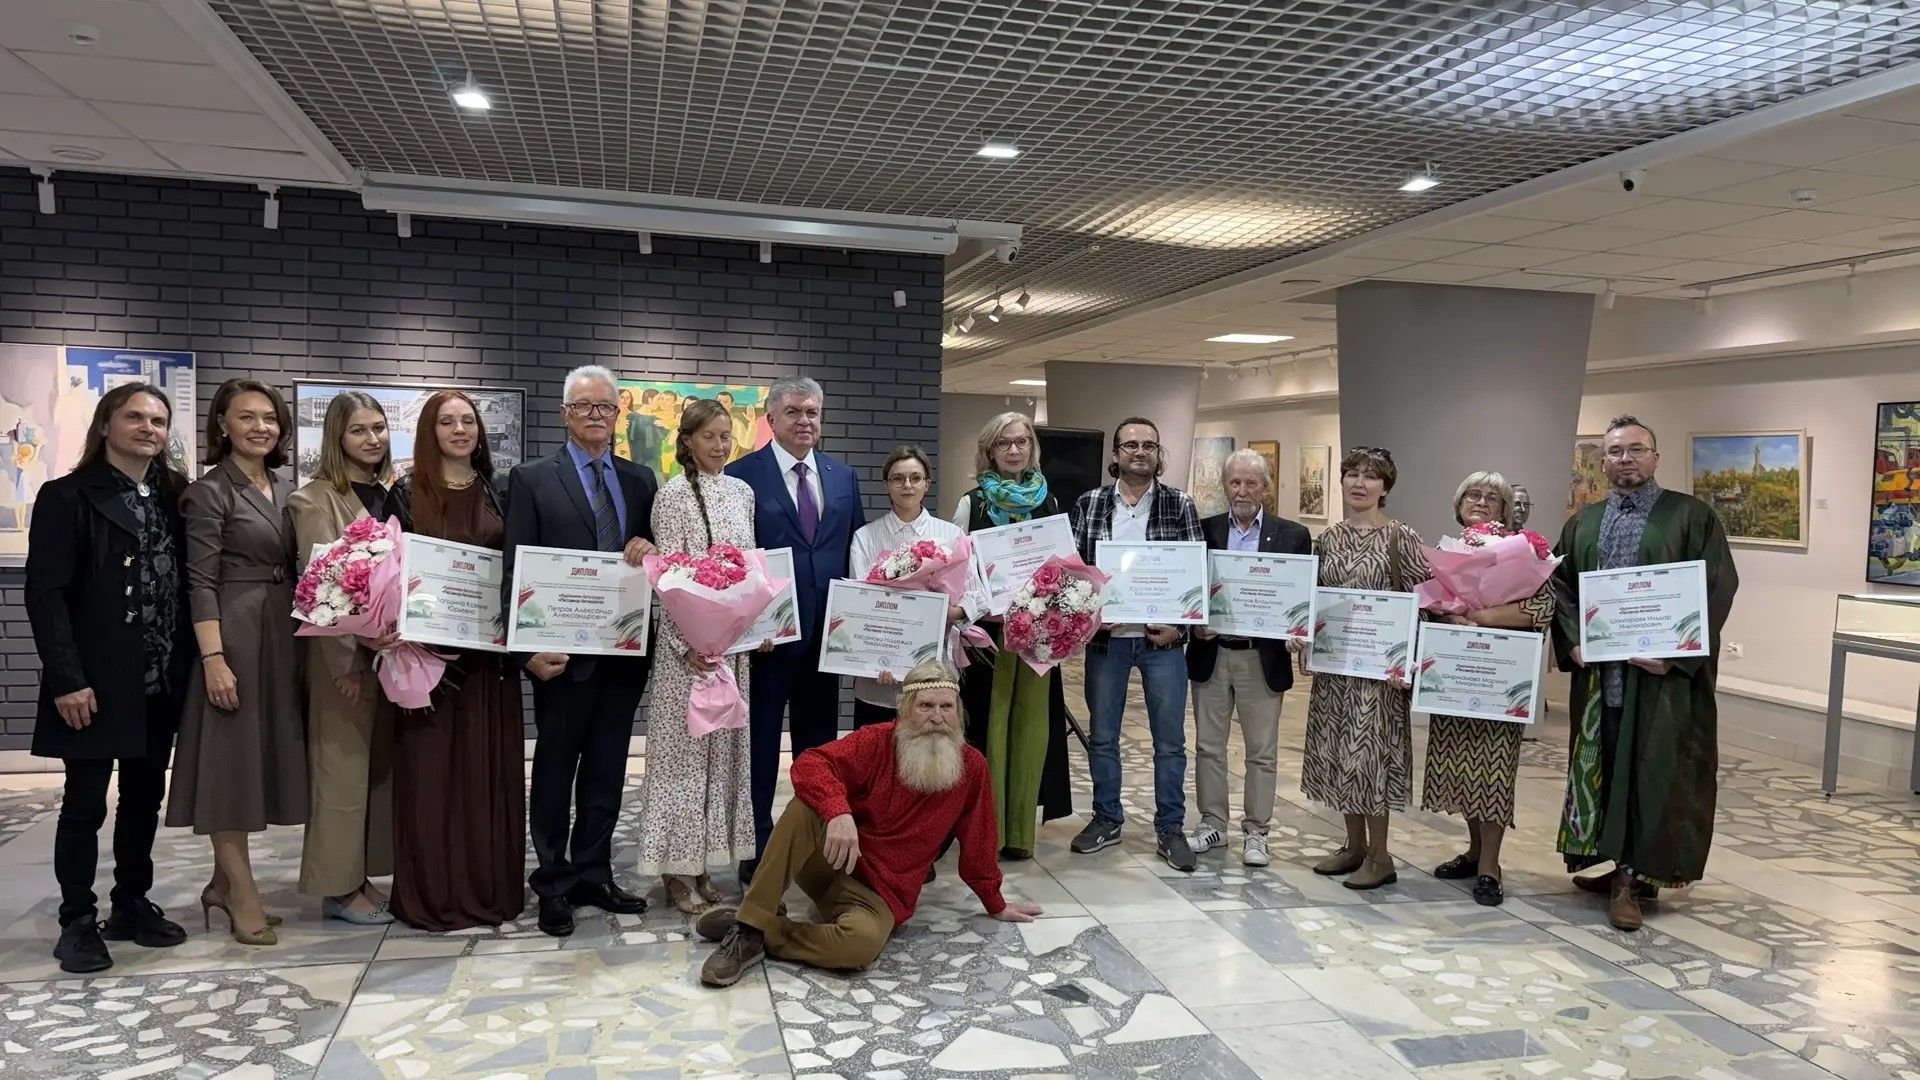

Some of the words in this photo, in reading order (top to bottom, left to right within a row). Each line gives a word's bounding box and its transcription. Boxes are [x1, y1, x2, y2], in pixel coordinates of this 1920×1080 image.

[452, 560, 475, 571] ДИПЛОМ
[1249, 566, 1271, 574] ДИПЛОМ
[570, 567, 598, 576] ДИПЛОМ
[1627, 581, 1652, 590] ДИПЛОМ
[547, 604, 573, 613] Петров
[574, 606, 613, 615] Александр
[874, 600, 899, 610] ДИПЛОМ
[1352, 603, 1373, 612] ДИПЛОМ
[552, 611, 607, 620] Александрович
[1466, 641, 1491, 650] ДИПЛОМ
[1481, 677, 1508, 686] Марина
